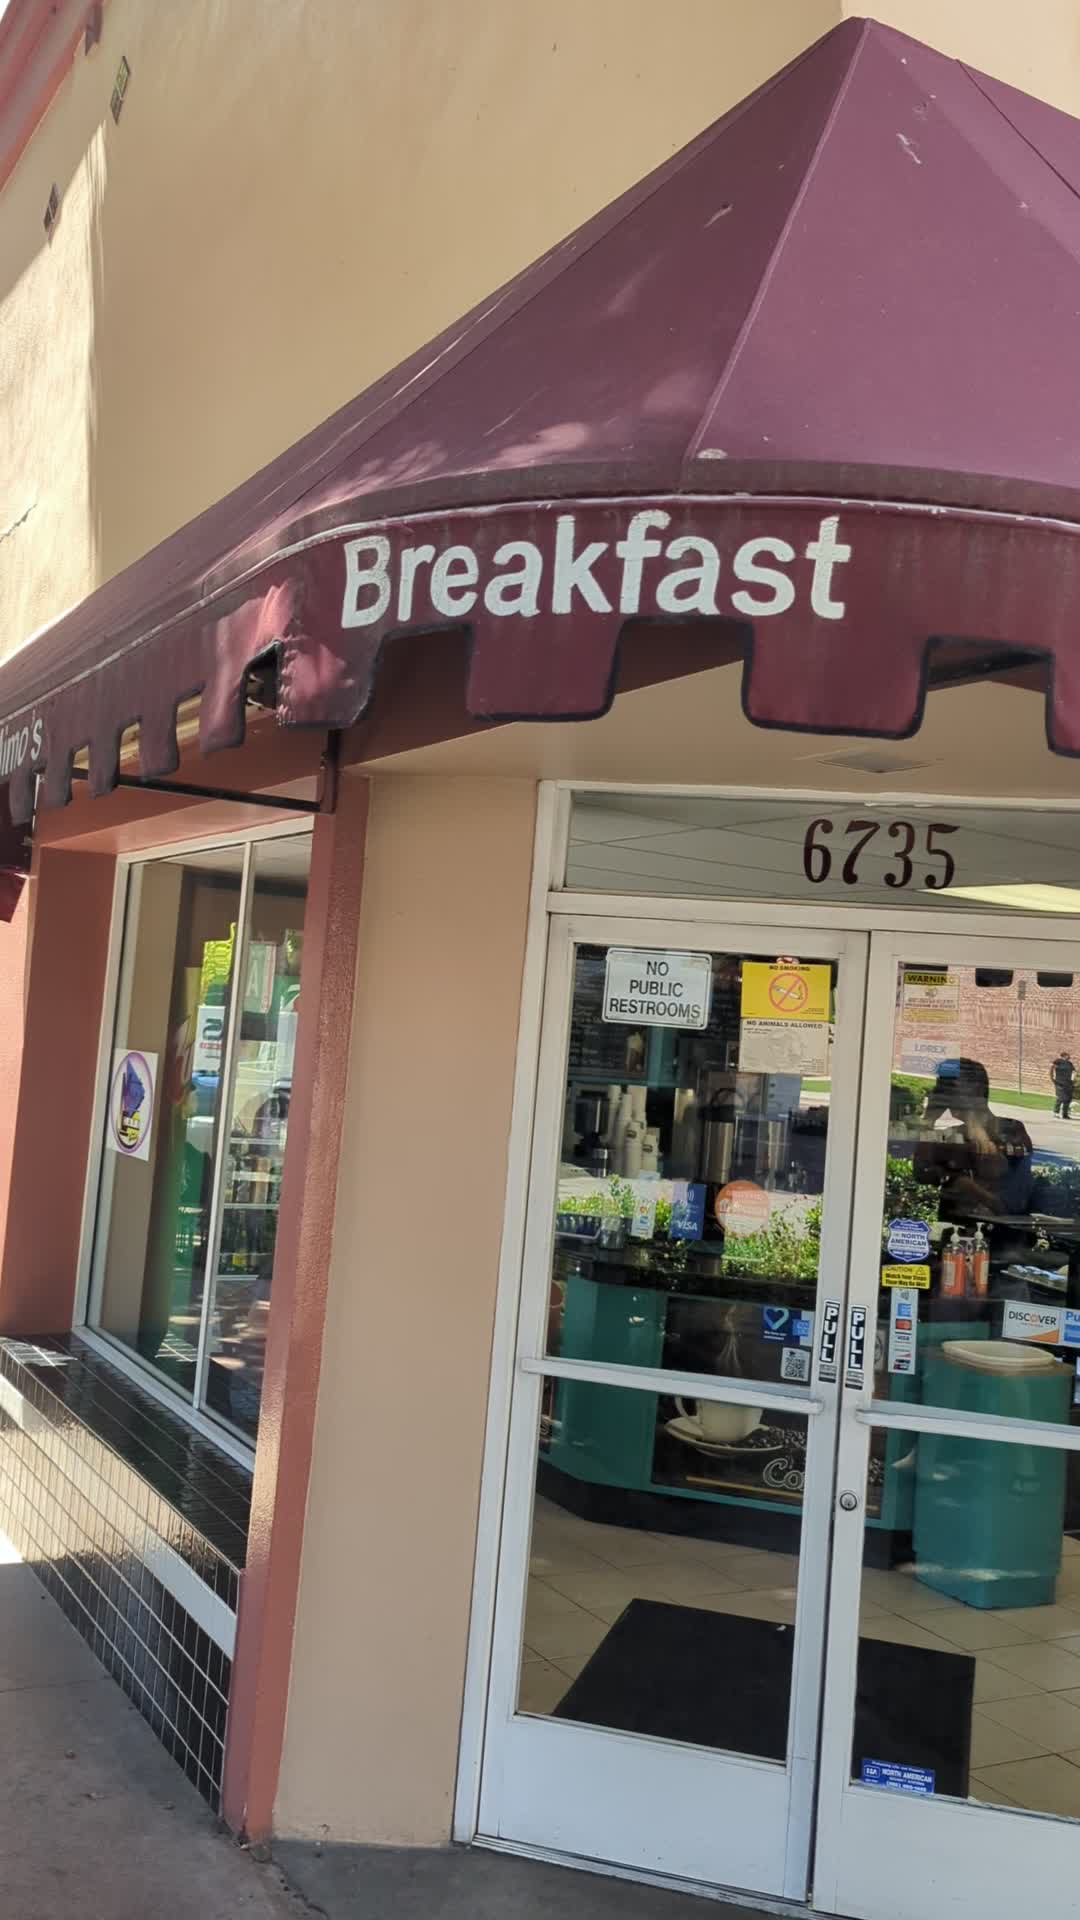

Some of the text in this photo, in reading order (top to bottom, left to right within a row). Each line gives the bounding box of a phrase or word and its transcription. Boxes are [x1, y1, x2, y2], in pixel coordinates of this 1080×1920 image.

[341, 510, 851, 629] Breakfast
[803, 818, 960, 889] 6735
[646, 960, 669, 976] NO
[629, 980, 683, 997] PUBLIC
[609, 998, 701, 1018] RESTROOMS
[676, 1220, 698, 1232] VISA
[1008, 1310, 1057, 1326] DISCOVER
[821, 1307, 838, 1362] PULL
[850, 1312, 865, 1368] PULL
[902, 1770, 932, 1783] AMERICAN
